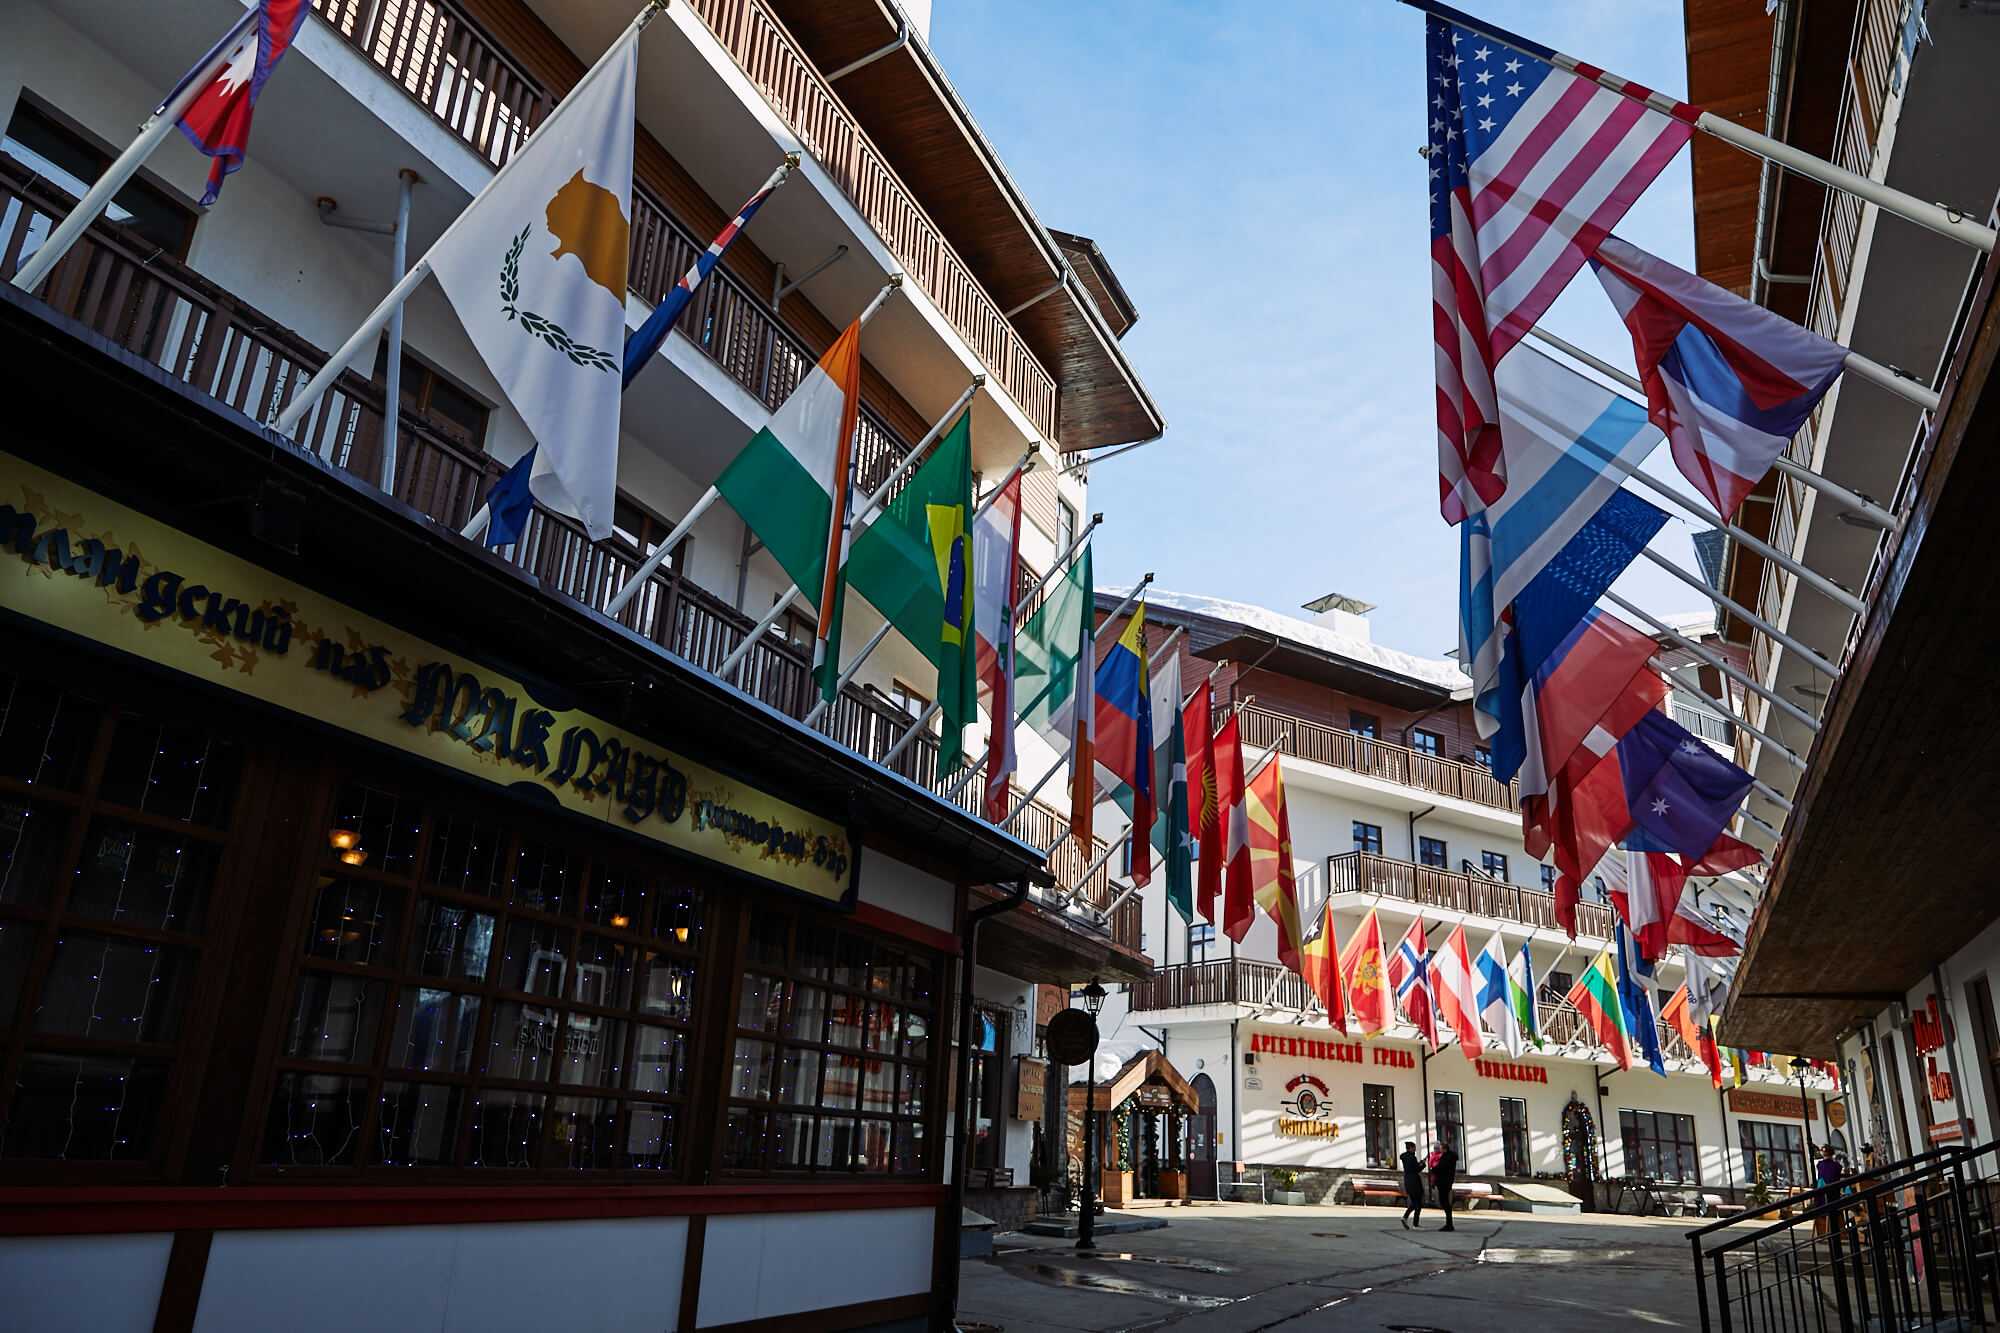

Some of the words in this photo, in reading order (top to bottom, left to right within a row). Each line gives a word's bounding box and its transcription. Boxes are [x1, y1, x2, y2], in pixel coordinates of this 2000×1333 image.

[1251, 1033, 1363, 1065] АРГЕНТИНСКИЙ
[1373, 1046, 1416, 1069] ГРИЛЬ
[1475, 1058, 1548, 1084] ЧУПАКАБРА
